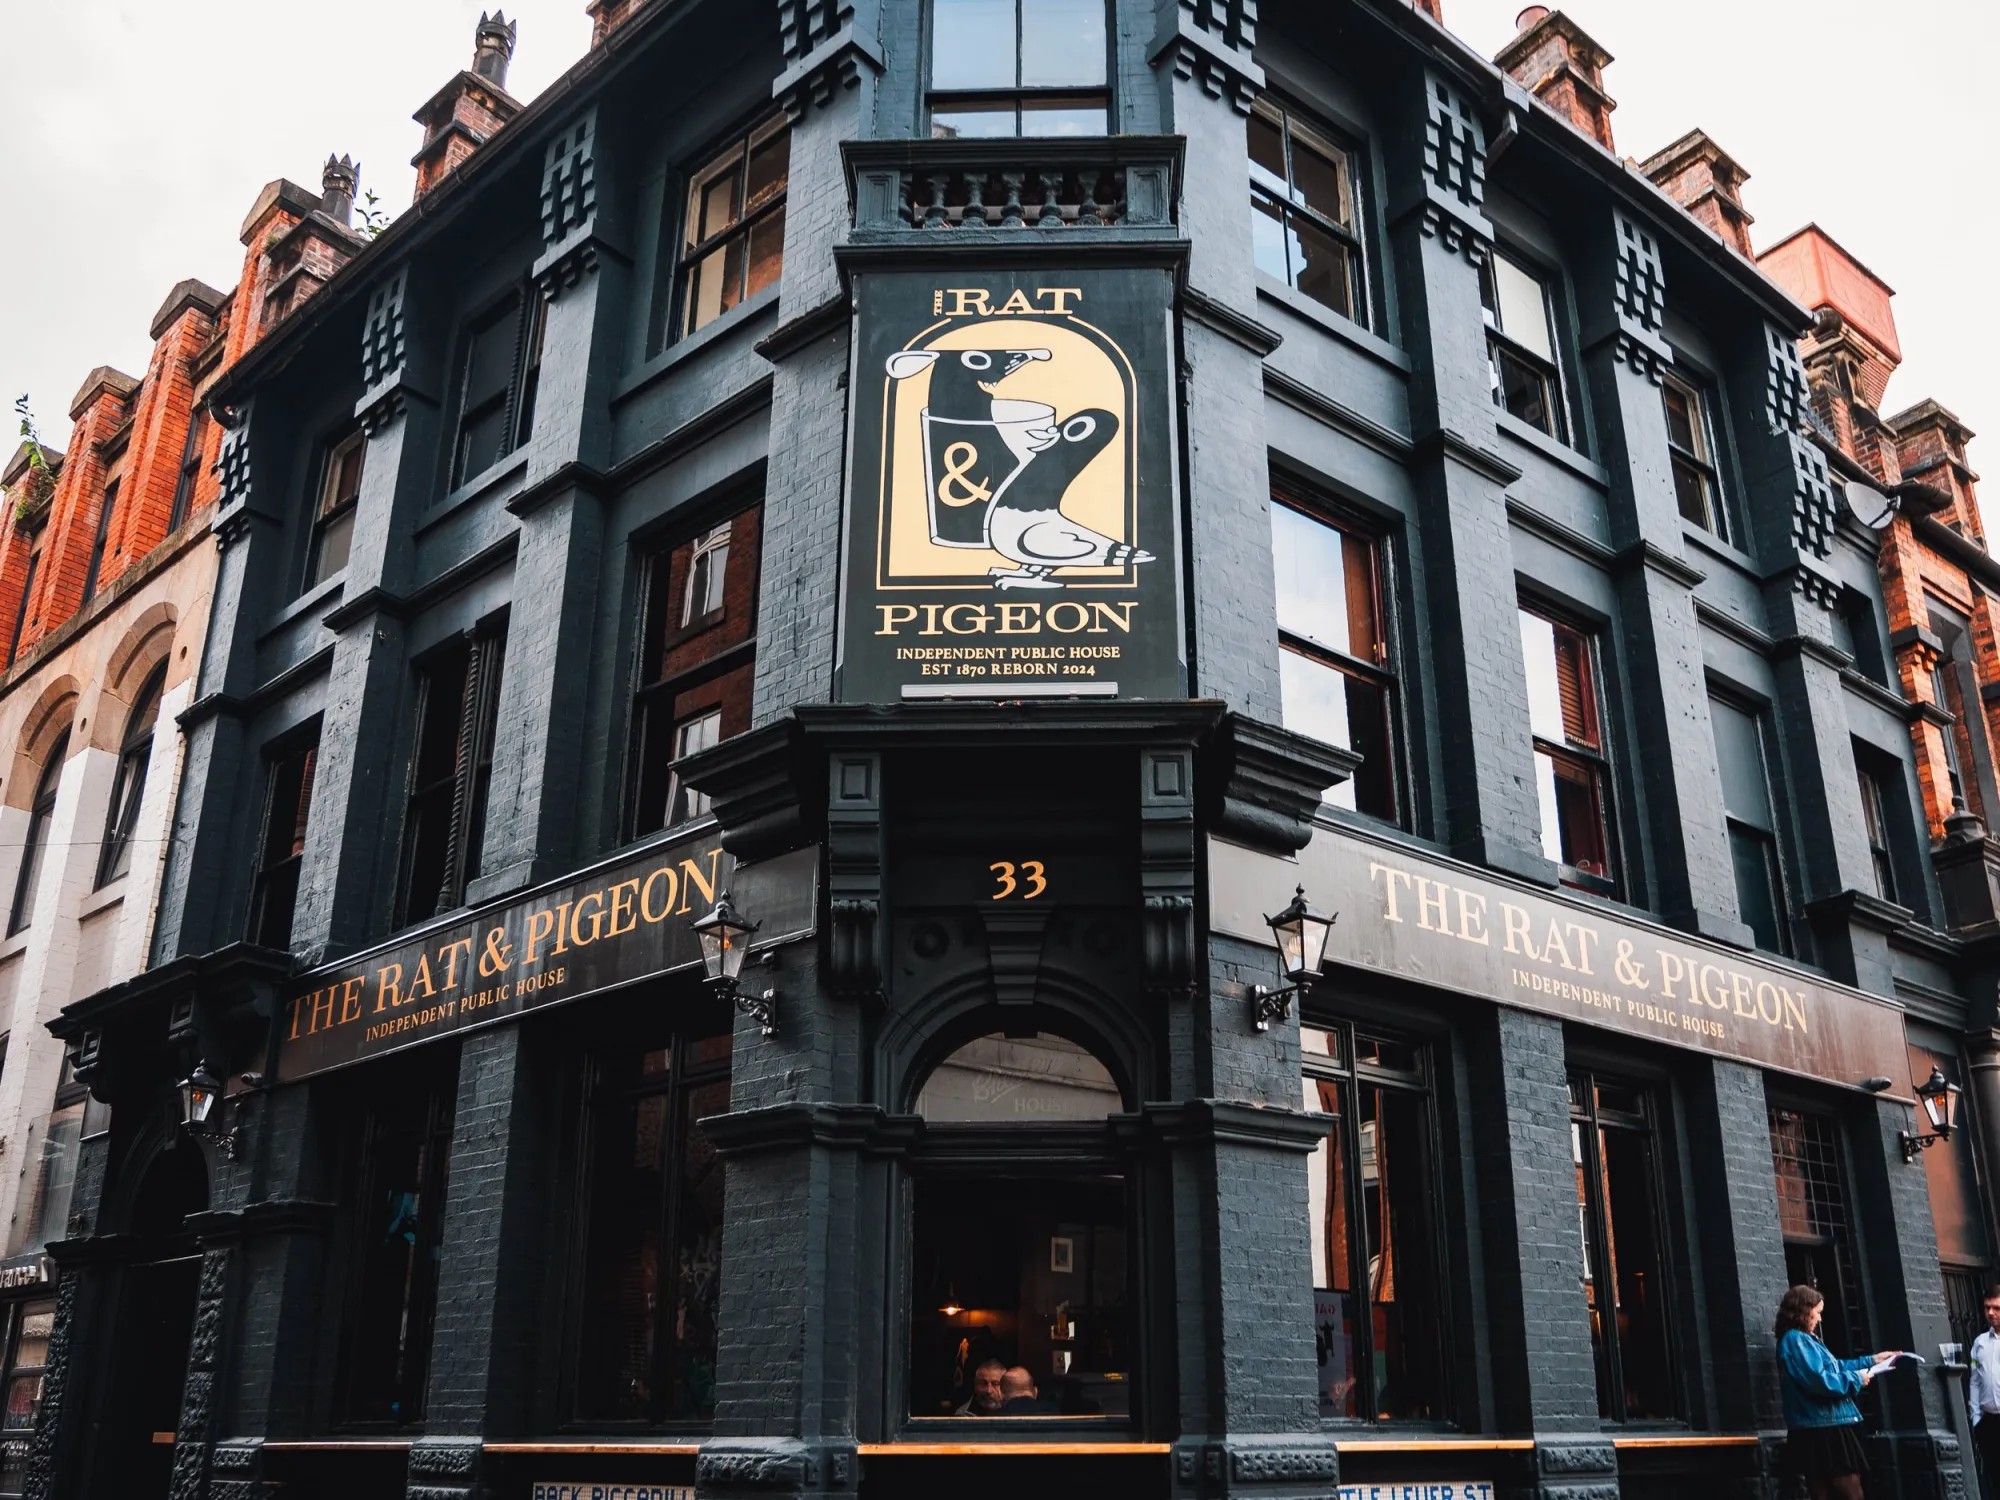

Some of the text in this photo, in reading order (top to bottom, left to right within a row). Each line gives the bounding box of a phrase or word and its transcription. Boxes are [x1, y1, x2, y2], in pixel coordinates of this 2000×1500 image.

[933, 287, 1082, 317] THE RAT
[938, 441, 993, 508] &
[874, 601, 1139, 636] PIGEON
[897, 646, 1121, 660] INDEPENDENT PUBLIC HOUSE
[921, 663, 1096, 678] EST 1870 REBORN 2024
[989, 860, 1047, 900] 33
[286, 847, 724, 1042] THE RAT & PIGEON
[1370, 862, 1809, 1034] THE RAT & PIGEON
[366, 967, 566, 1042] INDEPENDENT PUBLIC HOUSE
[1512, 968, 1725, 1039] INDEPENDENT PUBLIC HOUSE
[534, 1485, 688, 1500] BACK PICCADILL
[1463, 1484, 1492, 1500] ST
